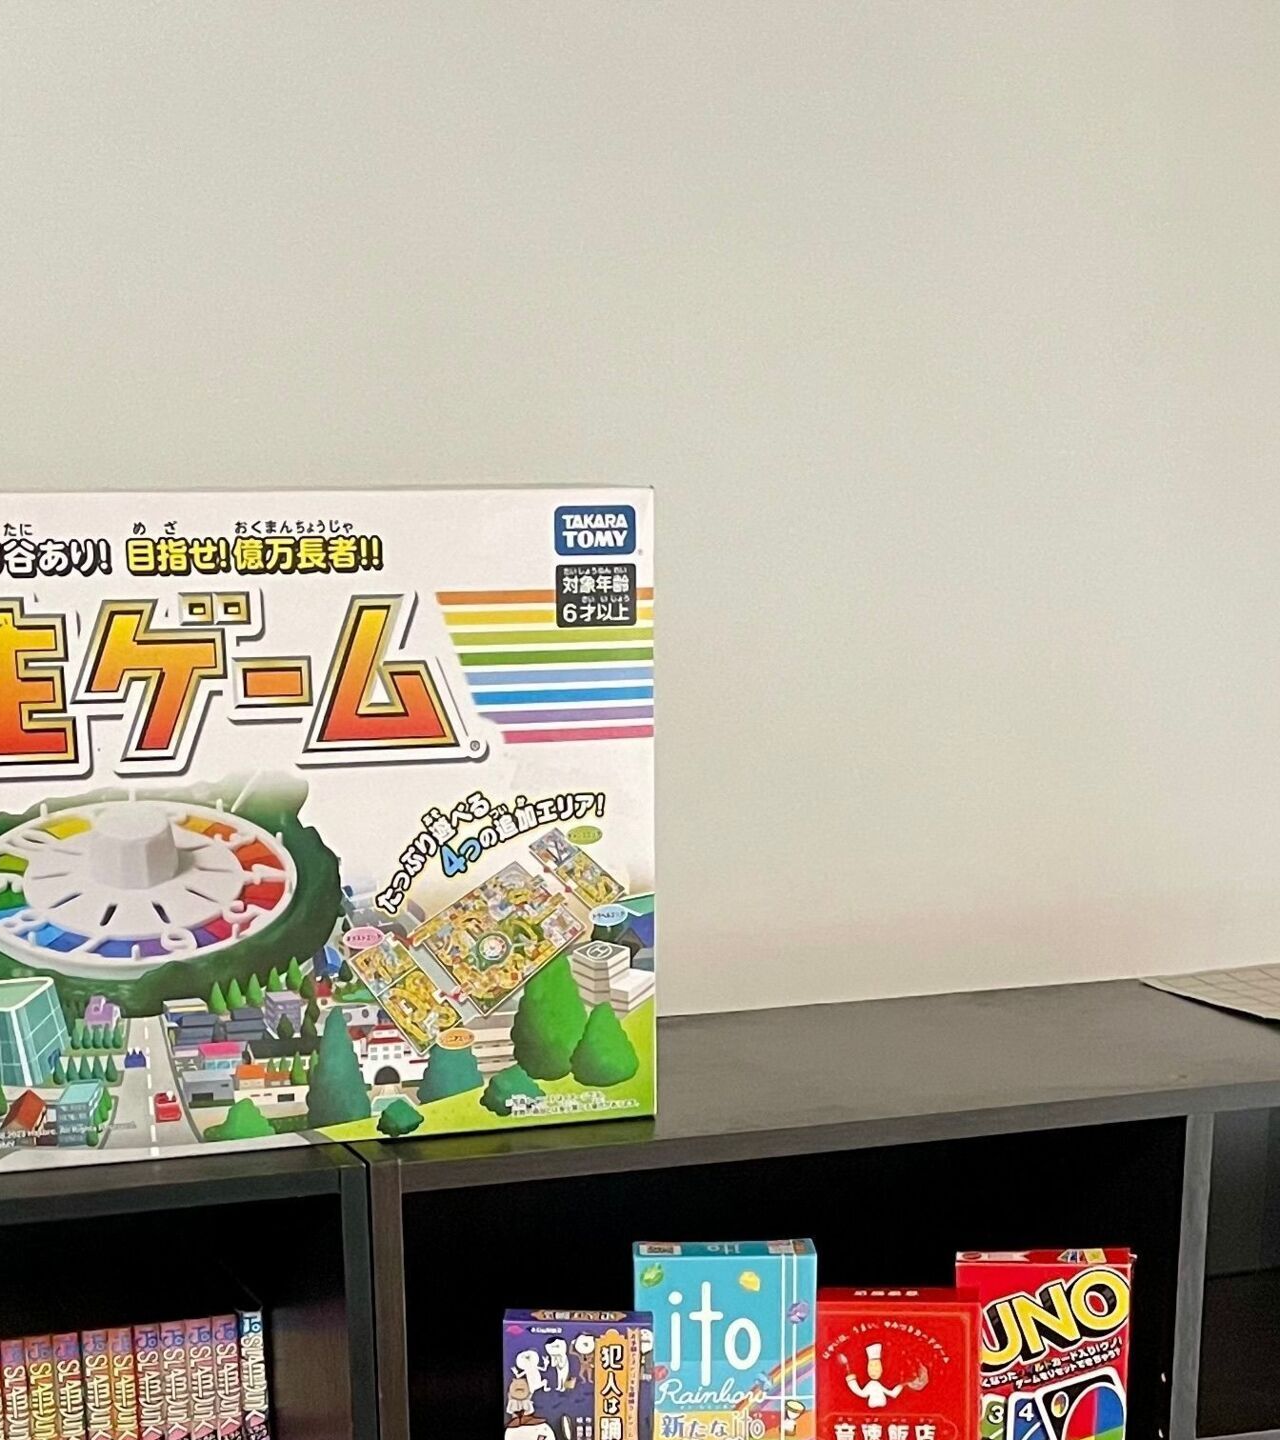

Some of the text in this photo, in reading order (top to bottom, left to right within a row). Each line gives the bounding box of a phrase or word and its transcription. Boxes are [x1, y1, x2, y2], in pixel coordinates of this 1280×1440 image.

[4, 523, 33, 536] たに
[562, 514, 628, 529] TAKARA
[562, 530, 628, 548] TOMY
[562, 575, 629, 594] 対象年齢
[563, 603, 630, 623] 6才以上
[439, 792, 606, 877] 4つの追加エリア!
[981, 1267, 1130, 1366] UNO
[668, 1280, 762, 1388] ito
[987, 1404, 1004, 1423] 3
[1018, 1403, 1035, 1421] 4
